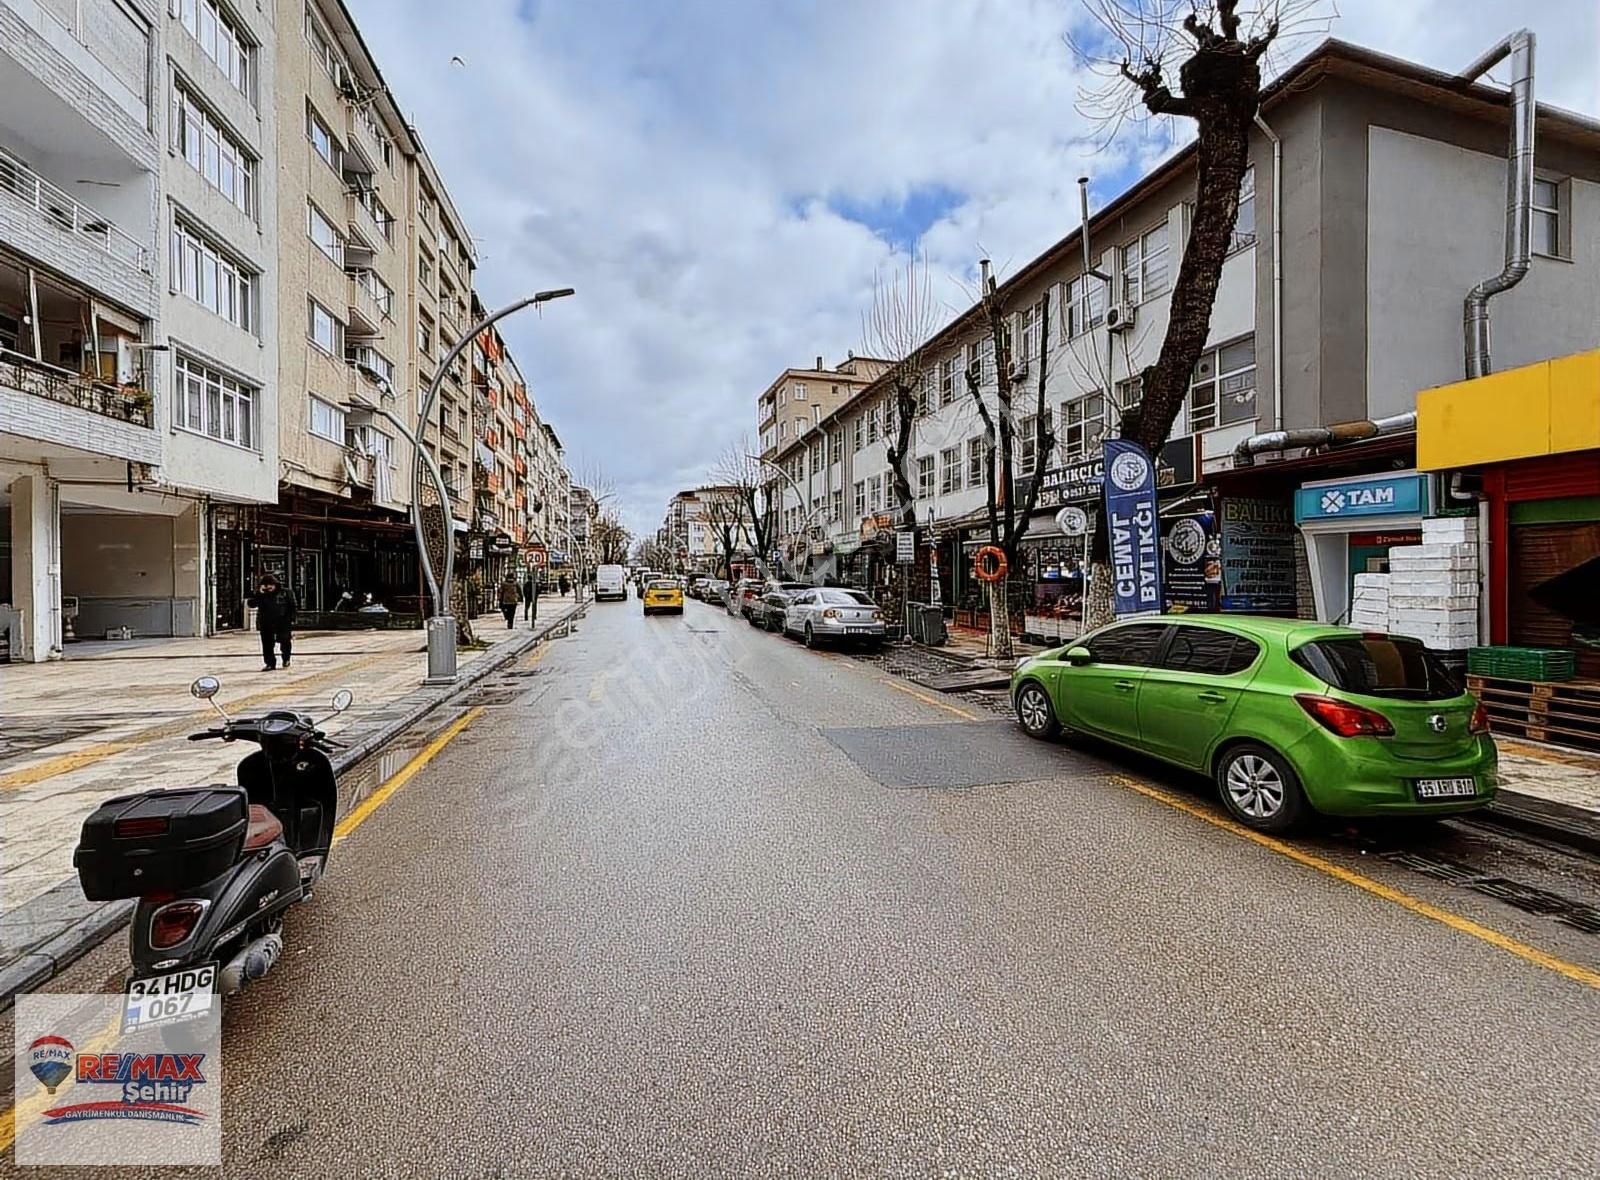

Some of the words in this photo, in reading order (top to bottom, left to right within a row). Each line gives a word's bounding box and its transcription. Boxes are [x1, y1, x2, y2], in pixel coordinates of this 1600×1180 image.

[1043, 465, 1092, 488] BALIKÇI
[1347, 487, 1394, 505] TAM
[529, 553, 540, 563] 20
[773, 550, 780, 560] P
[131, 978, 160, 1002] 34
[164, 969, 212, 996] HDG
[149, 992, 194, 1019] 067
